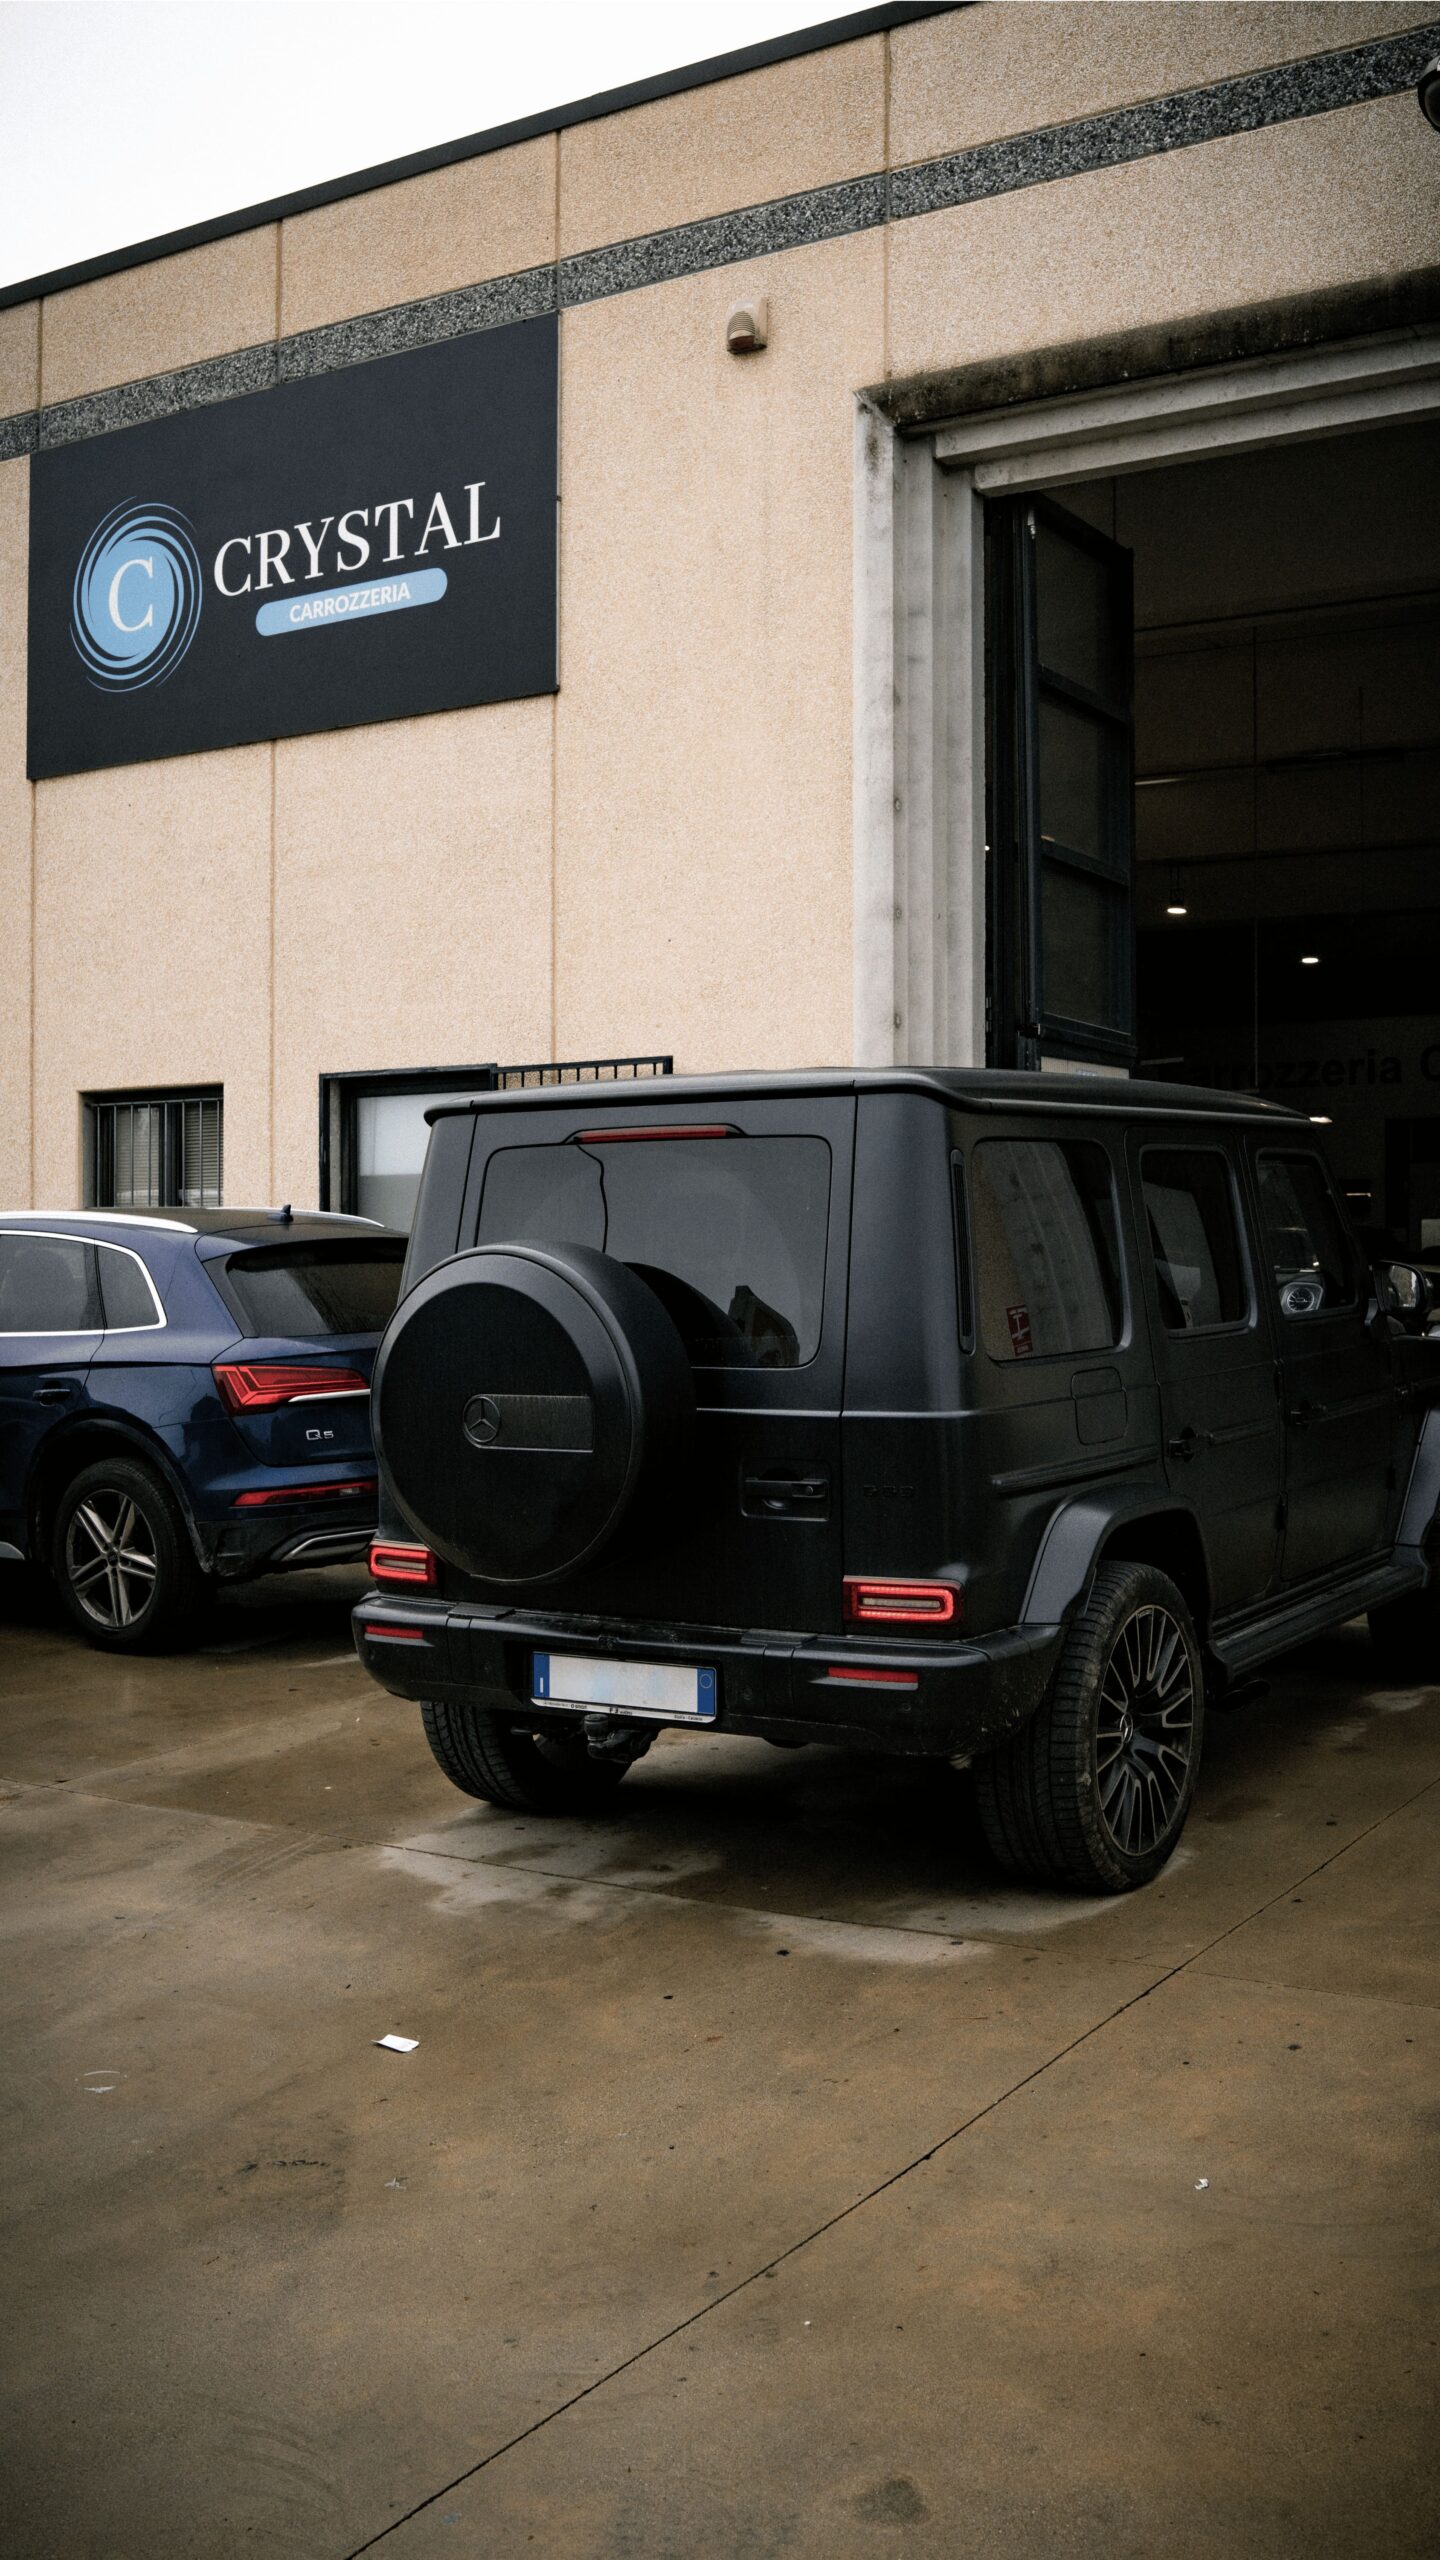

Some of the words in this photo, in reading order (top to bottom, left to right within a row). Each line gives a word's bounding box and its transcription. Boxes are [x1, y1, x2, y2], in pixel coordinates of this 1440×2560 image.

[213, 481, 501, 597] CRYSTAL
[108, 556, 154, 634] C
[289, 581, 412, 624] CARROZZERIA
[1160, 1048, 1402, 1090] arrozzeria
[305, 1429, 335, 1441] Q5
